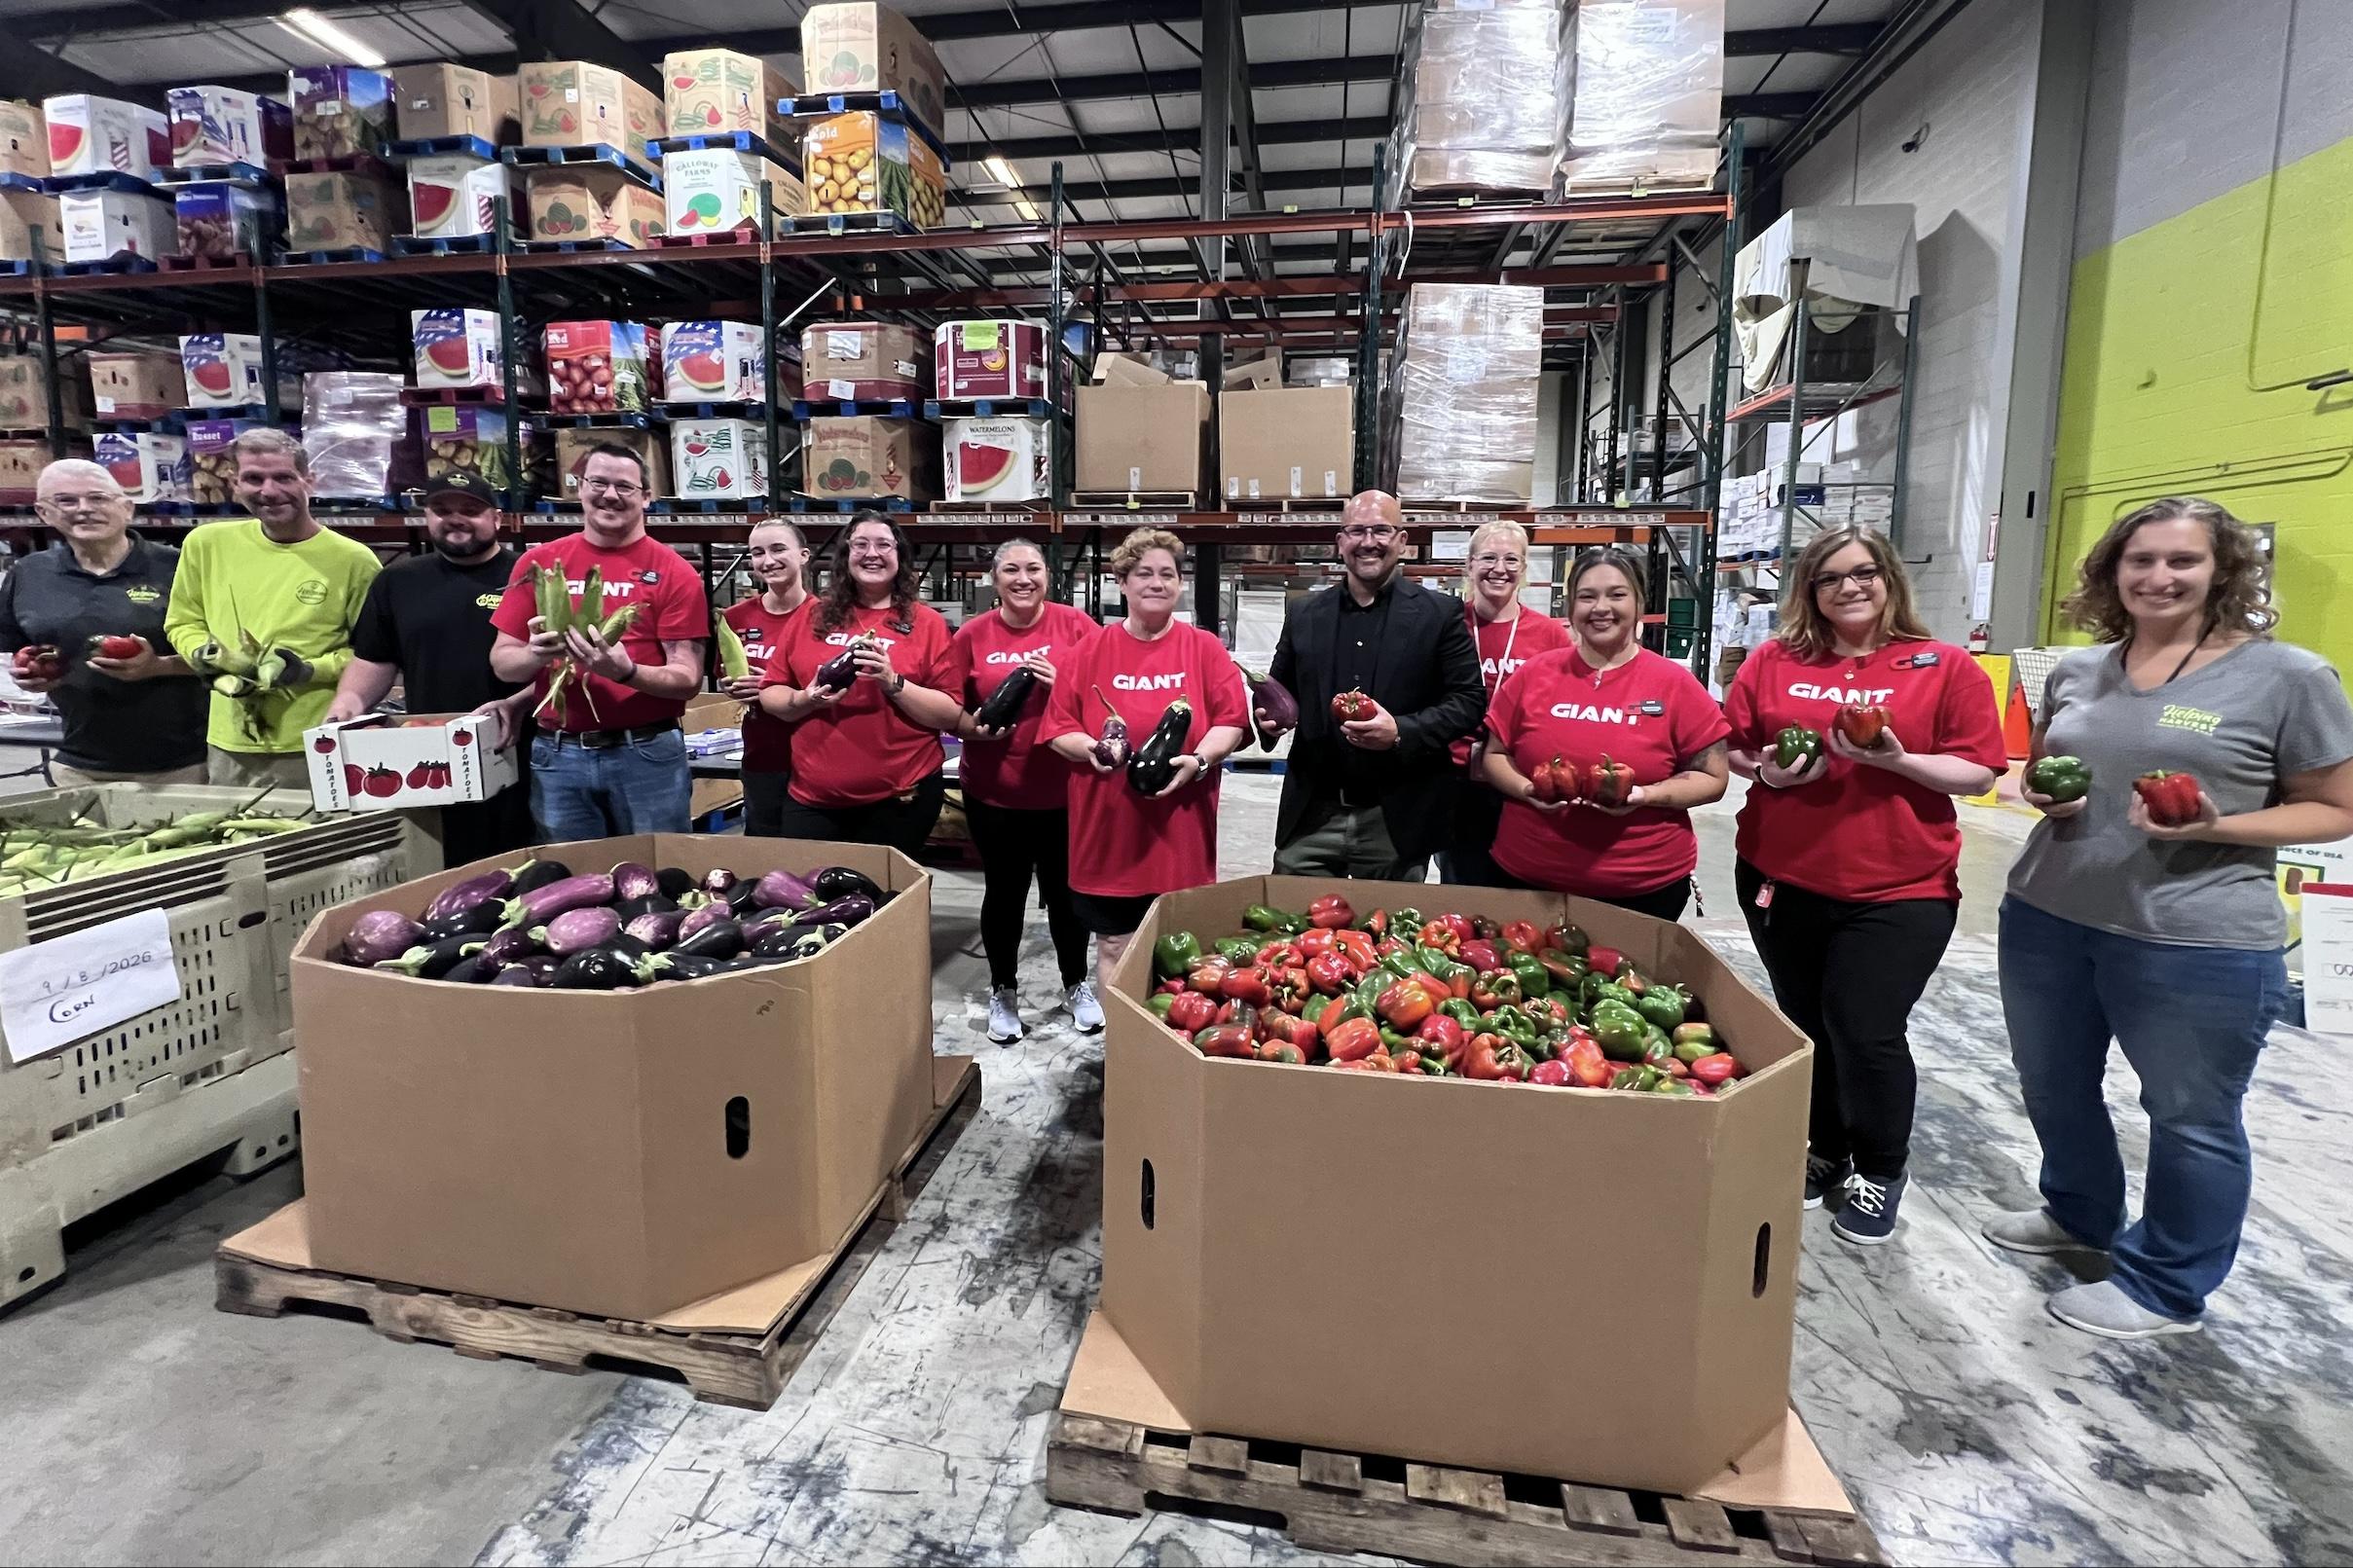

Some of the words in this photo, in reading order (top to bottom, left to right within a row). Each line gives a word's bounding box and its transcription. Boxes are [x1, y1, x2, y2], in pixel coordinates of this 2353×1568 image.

[676, 160, 718, 172] CALLOWAY
[566, 579, 635, 597] GINT
[1112, 672, 1186, 691] GIANT
[1787, 682, 1894, 705] GIANT
[324, 755, 339, 809] TOMATOES
[460, 748, 473, 799] TOMATOES
